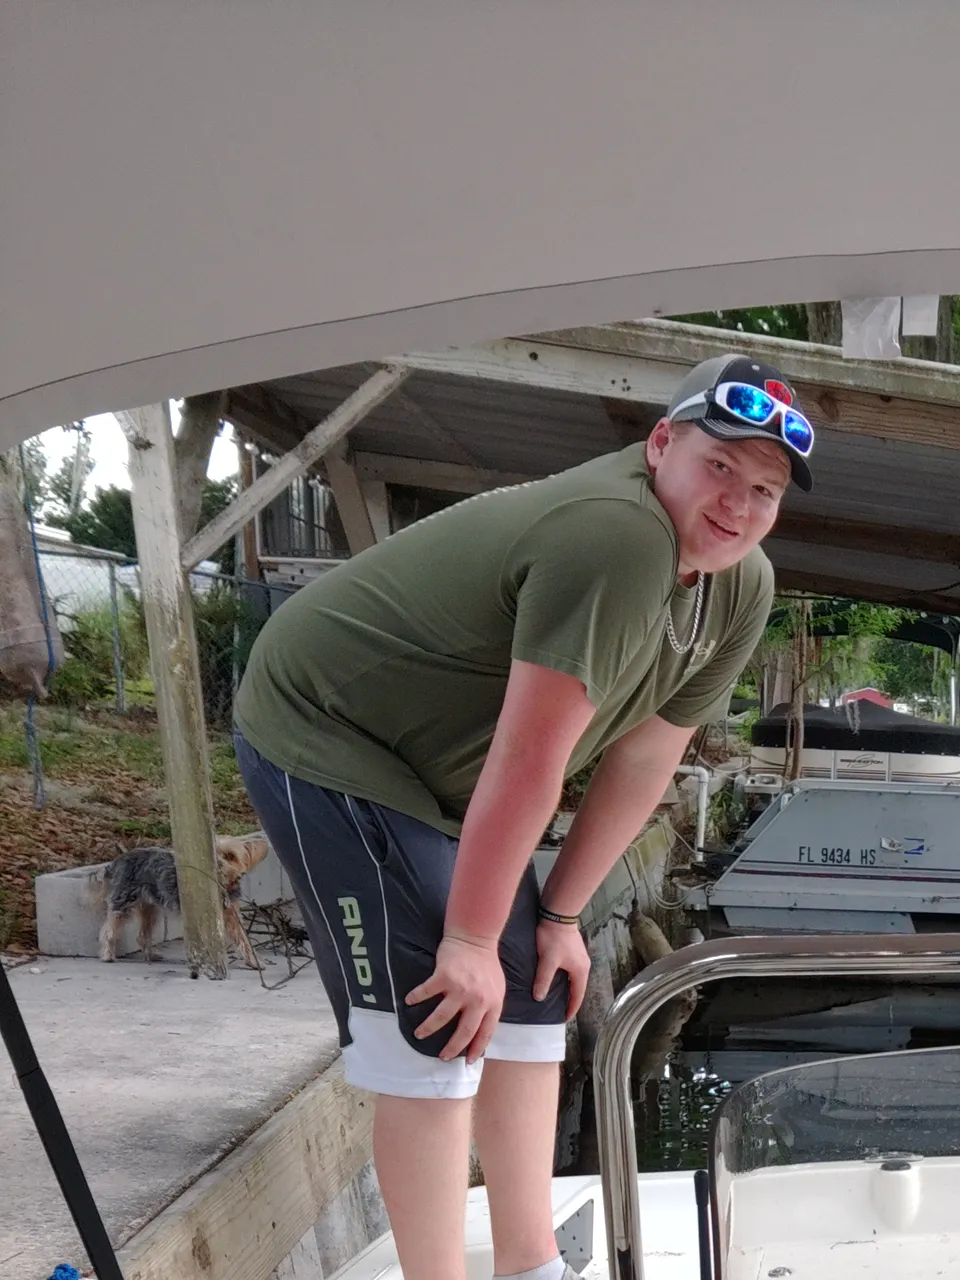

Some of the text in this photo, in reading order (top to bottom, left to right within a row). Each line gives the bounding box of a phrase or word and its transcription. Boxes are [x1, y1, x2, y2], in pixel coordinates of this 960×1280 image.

[799, 847, 876, 865] FL 9434 HS
[337, 897, 377, 1004] AND 1
